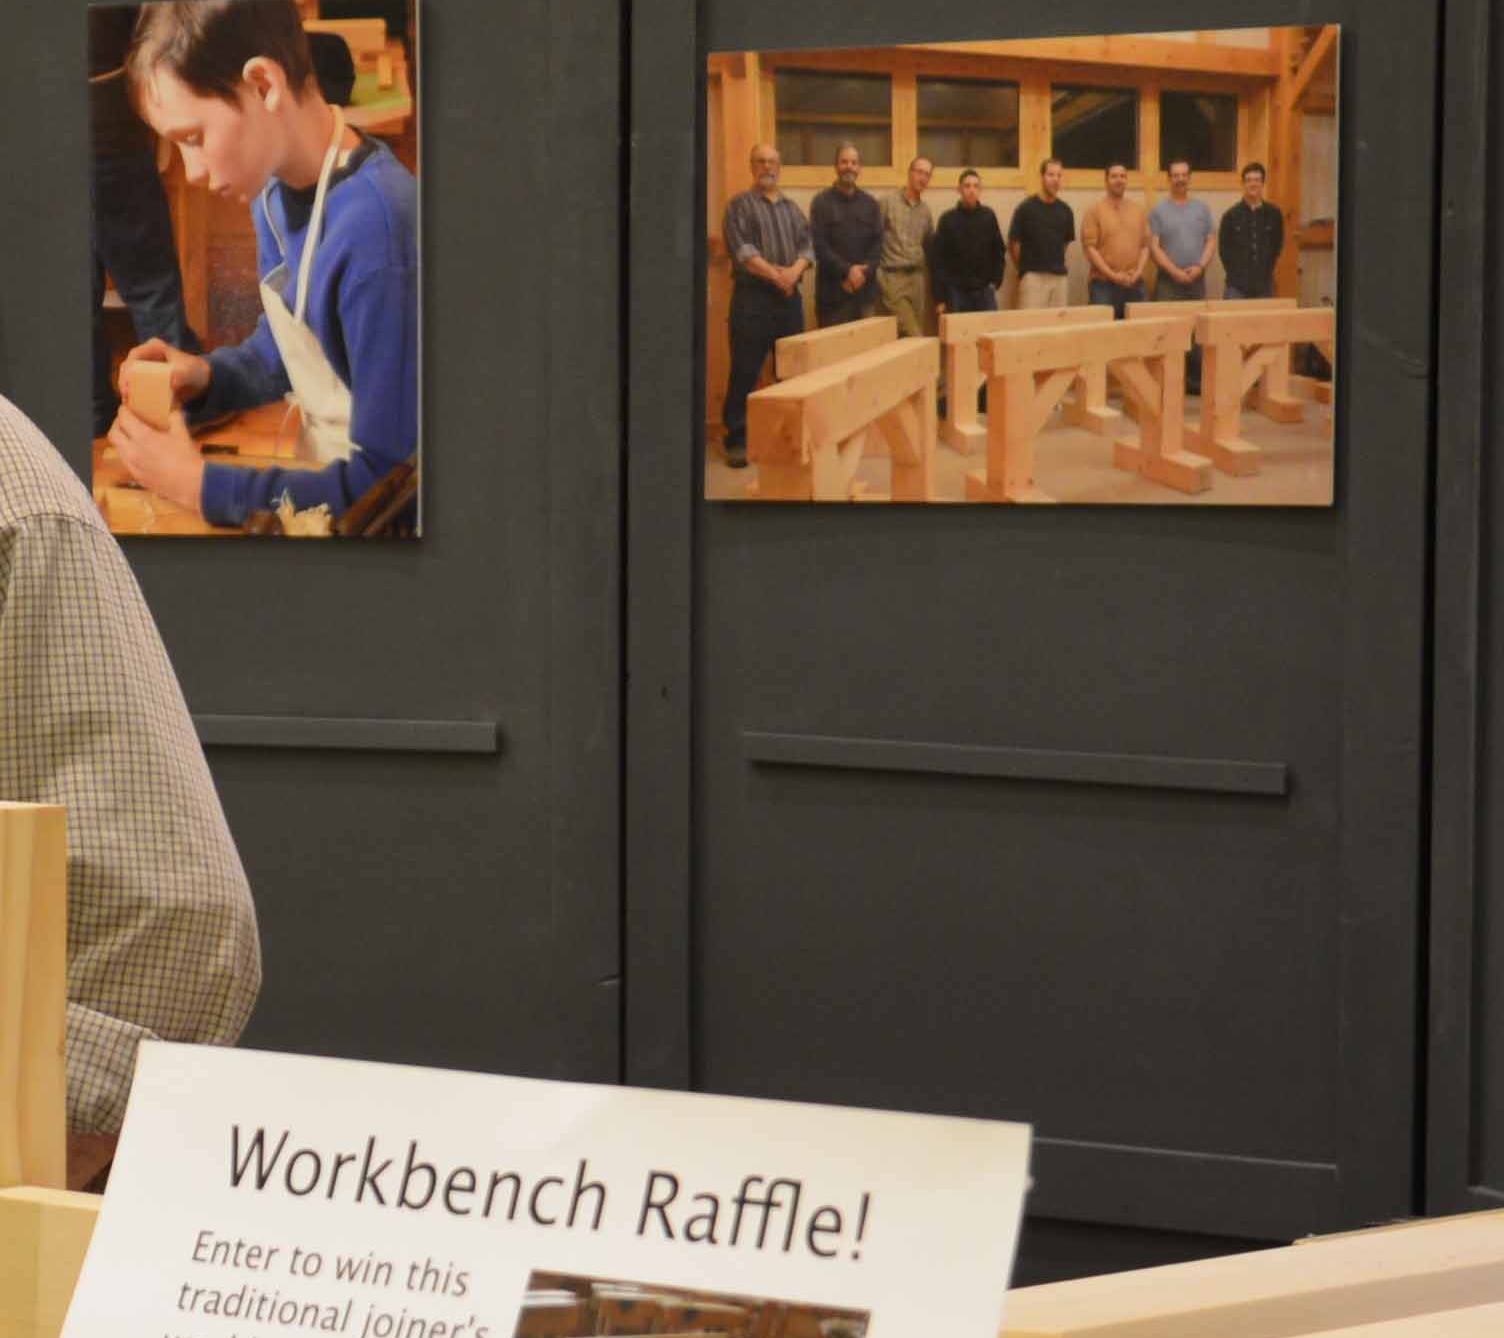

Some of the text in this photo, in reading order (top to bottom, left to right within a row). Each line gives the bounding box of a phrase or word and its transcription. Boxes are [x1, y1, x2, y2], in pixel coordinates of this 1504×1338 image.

[229, 1124, 870, 1261] Workbench Raffle!
[192, 1230, 470, 1298] Enter to win this
[177, 1281, 353, 1333] traditional
